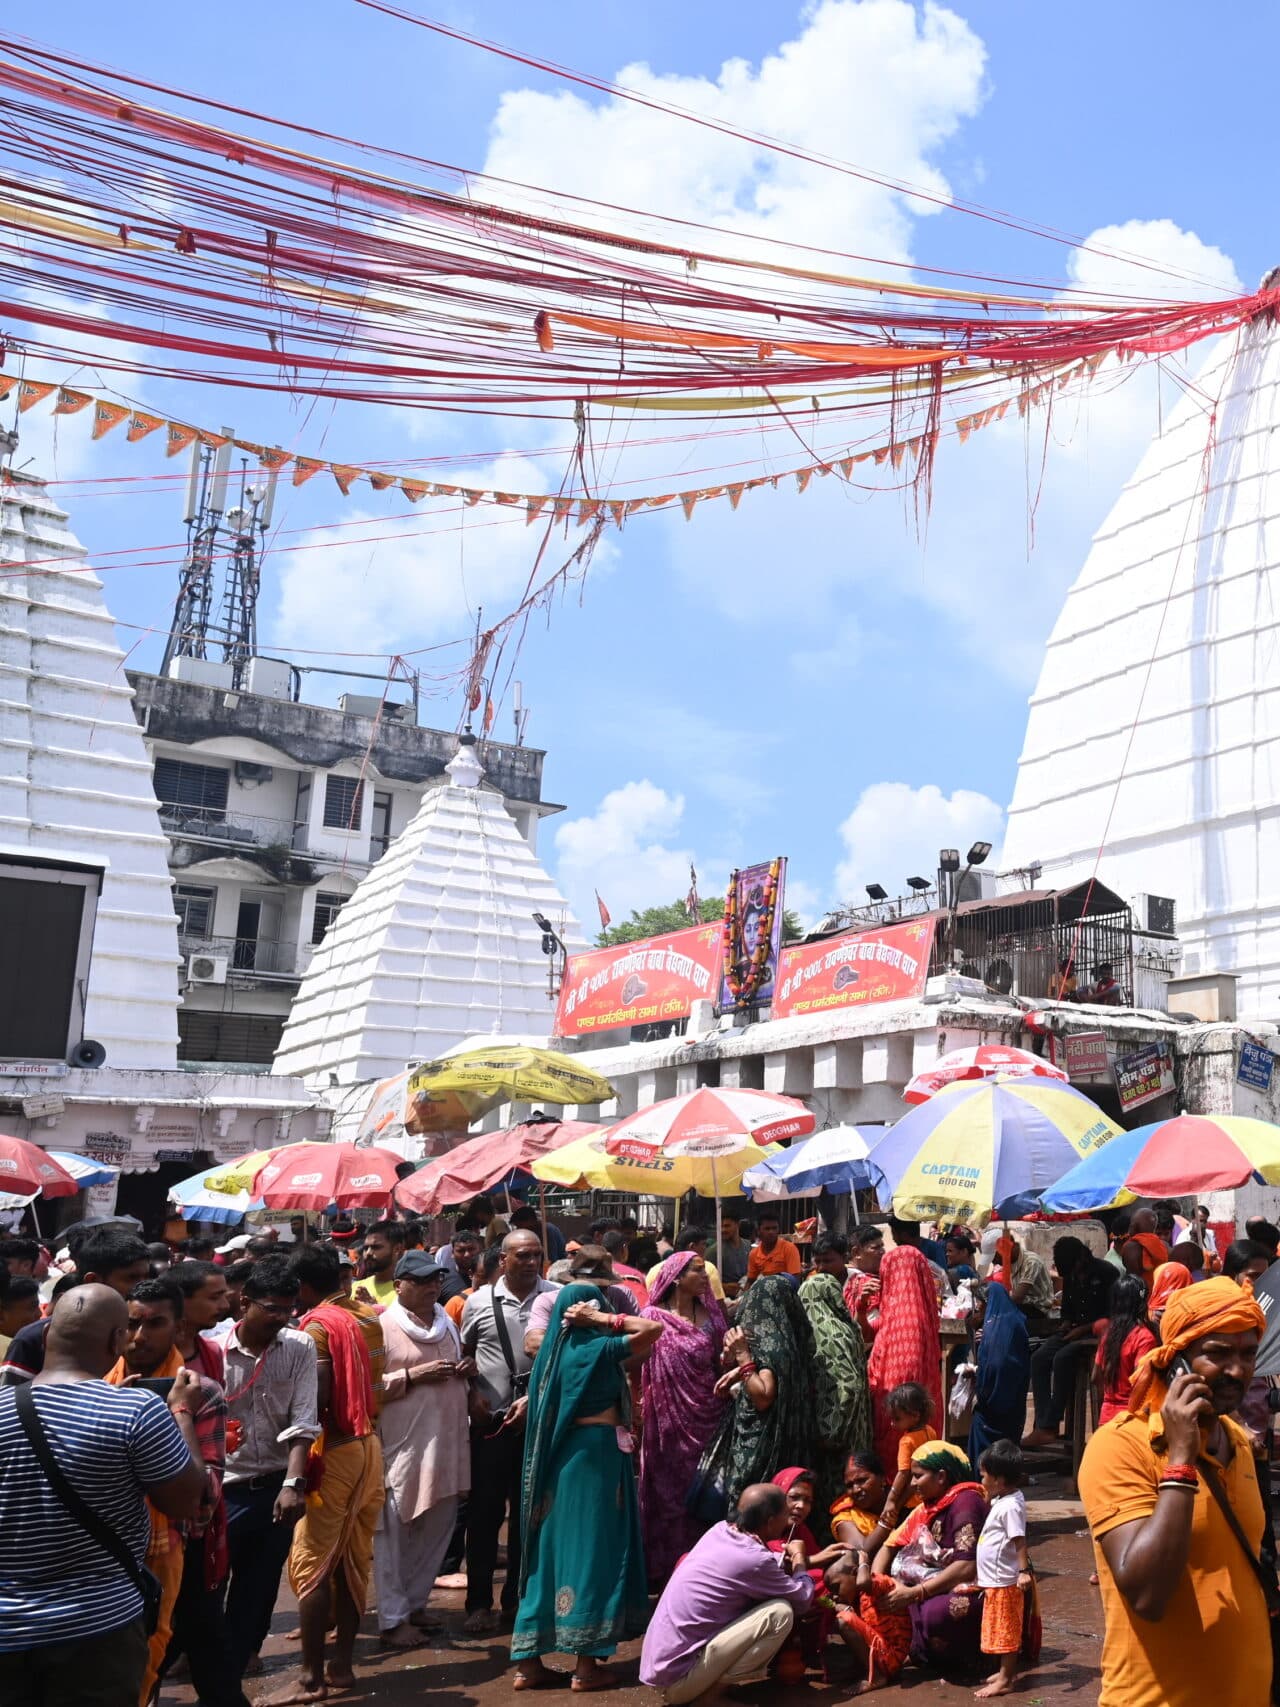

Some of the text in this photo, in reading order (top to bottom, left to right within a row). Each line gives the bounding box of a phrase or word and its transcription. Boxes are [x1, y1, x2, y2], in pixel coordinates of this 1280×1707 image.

[902, 953, 918, 980] धाम
[693, 963, 711, 992] धाम
[849, 990, 866, 1001] सभा
[638, 1006, 658, 1019] सभा
[762, 1122, 801, 1140] DEOGHAR
[1078, 1121, 1108, 1150] CAPTAIN
[620, 1144, 652, 1157] DEOGHAR
[921, 1163, 981, 1179] CAPTAIN
[958, 1179, 977, 1189] EQR
